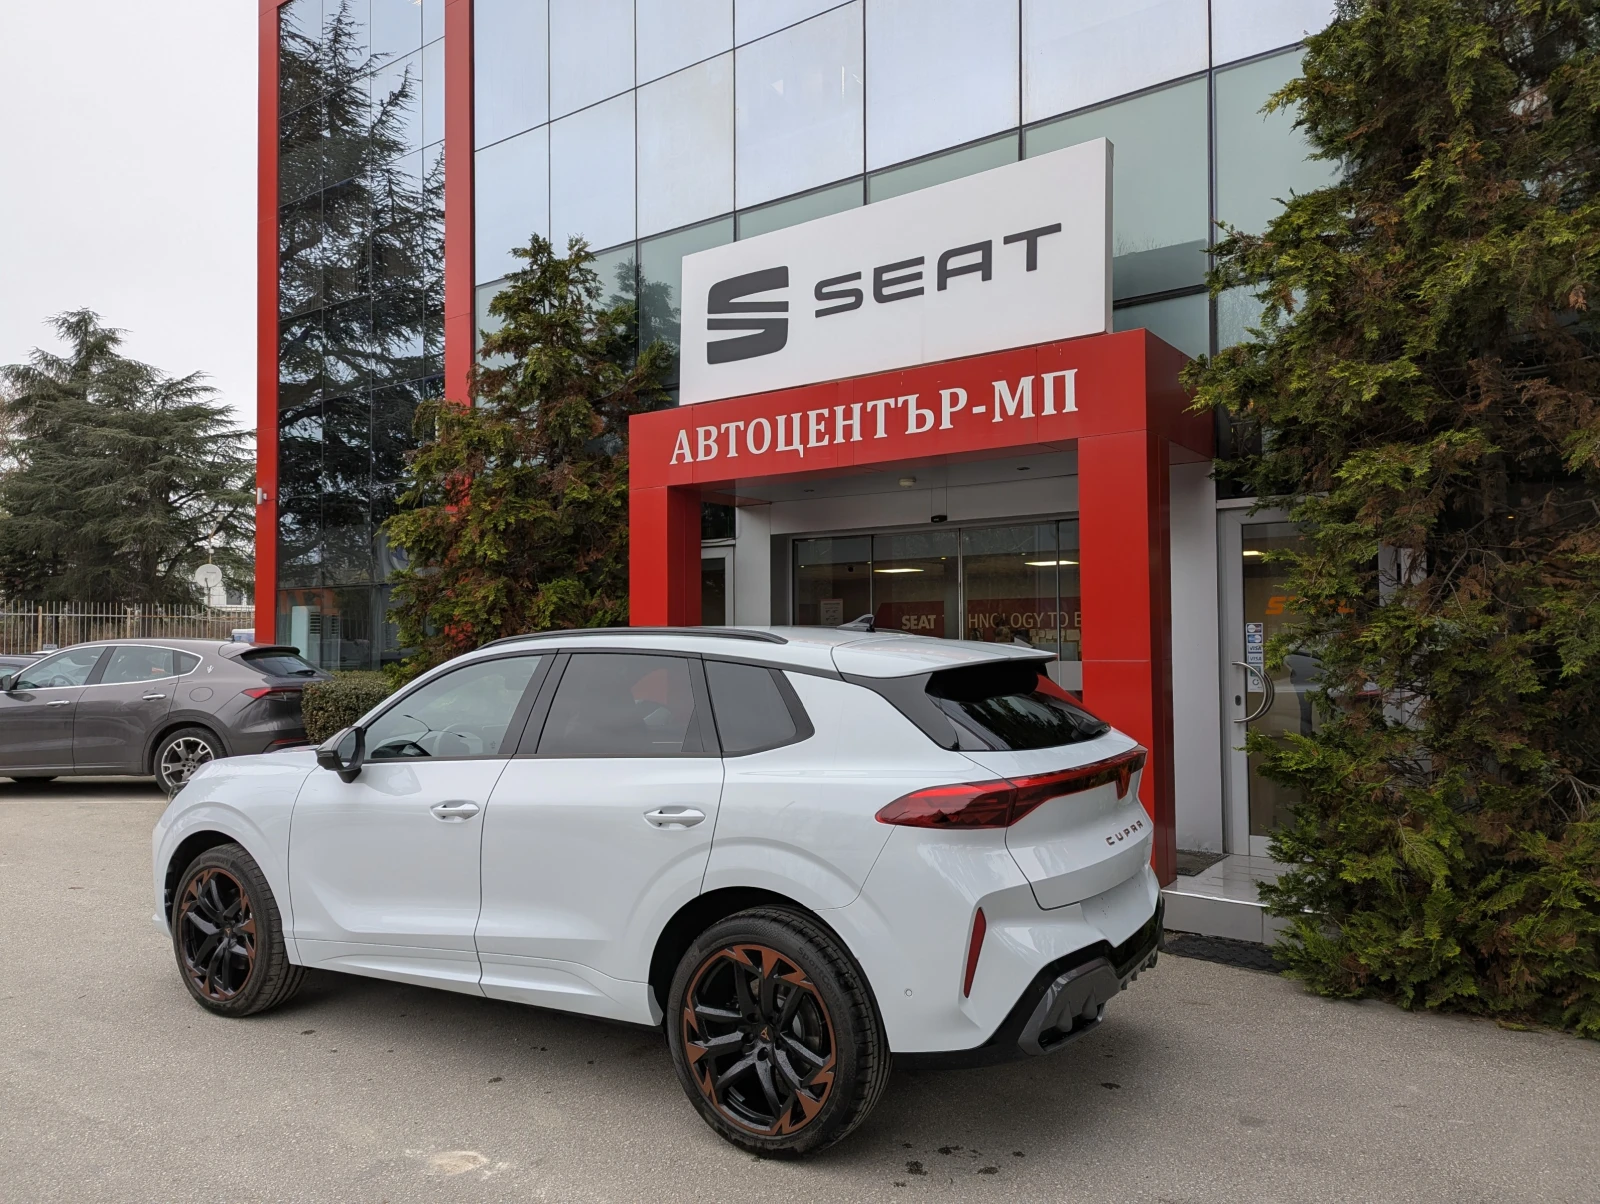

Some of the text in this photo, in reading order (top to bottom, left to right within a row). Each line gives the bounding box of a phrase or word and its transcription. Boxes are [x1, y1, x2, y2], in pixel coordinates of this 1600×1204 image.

[814, 222, 1062, 319] SEAT
[669, 368, 1080, 466] АВТОЦЕНТЪР-МП
[901, 614, 937, 630] SEAT
[1105, 819, 1144, 846] CUPRA
